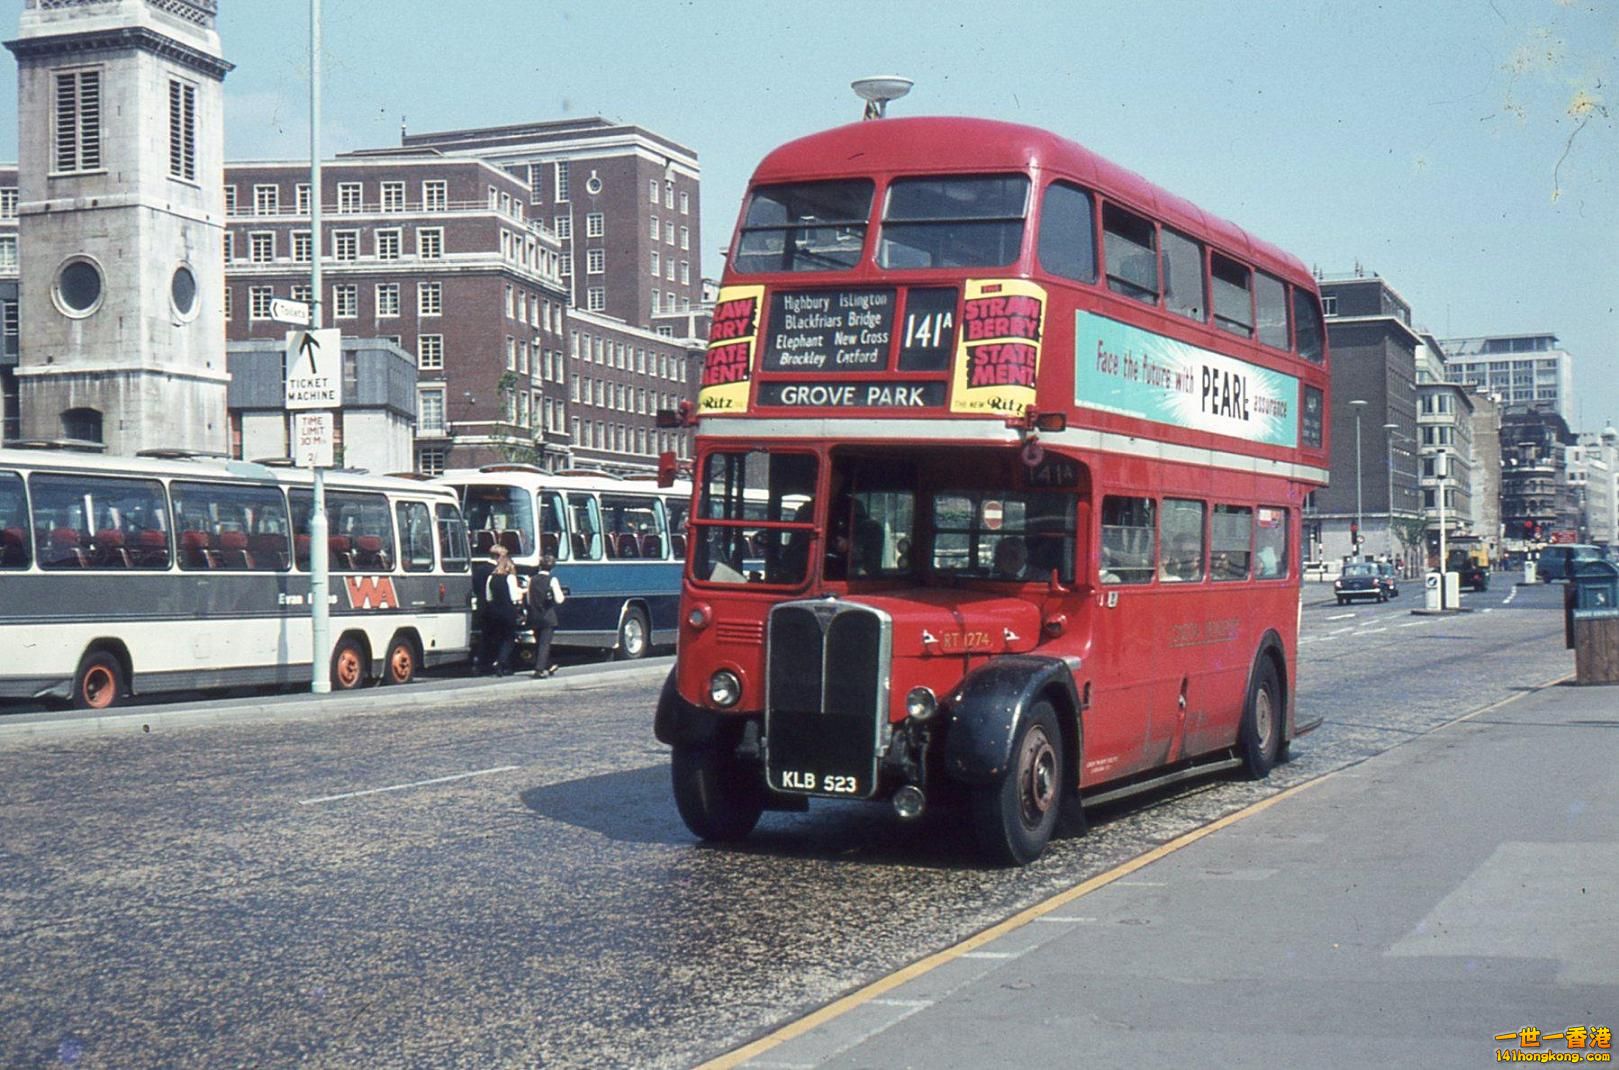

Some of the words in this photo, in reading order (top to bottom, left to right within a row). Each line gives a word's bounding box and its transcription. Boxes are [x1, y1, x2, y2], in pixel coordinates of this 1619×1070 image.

[784, 296, 829, 312] Highbury
[839, 294, 887, 310] Islington
[966, 296, 1040, 320] STRAW
[785, 314, 842, 330] Blackfriars
[848, 311, 881, 327] Bridge
[969, 316, 1037, 340] BERRY
[776, 335, 824, 350] Elephant
[834, 332, 856, 346] New
[860, 330, 888, 344] Cross
[780, 352, 826, 367] Brockley
[974, 343, 1035, 367] STATE
[290, 378, 328, 388] TICKET
[1095, 339, 1118, 375] Face
[1123, 350, 1138, 382] the
[1142, 353, 1170, 389] future
[1175, 365, 1194, 394] with
[1202, 365, 1249, 421] PEARL
[1253, 395, 1287, 418] assurance
[288, 390, 335, 401] MACHINE
[781, 386, 855, 406] GROVE
[867, 387, 924, 406] PARK
[302, 417, 323, 425] TIME
[302, 426, 325, 435] LIMIT
[944, 632, 959, 647] RT
[782, 771, 816, 789] KLB
[823, 775, 856, 793] 523
